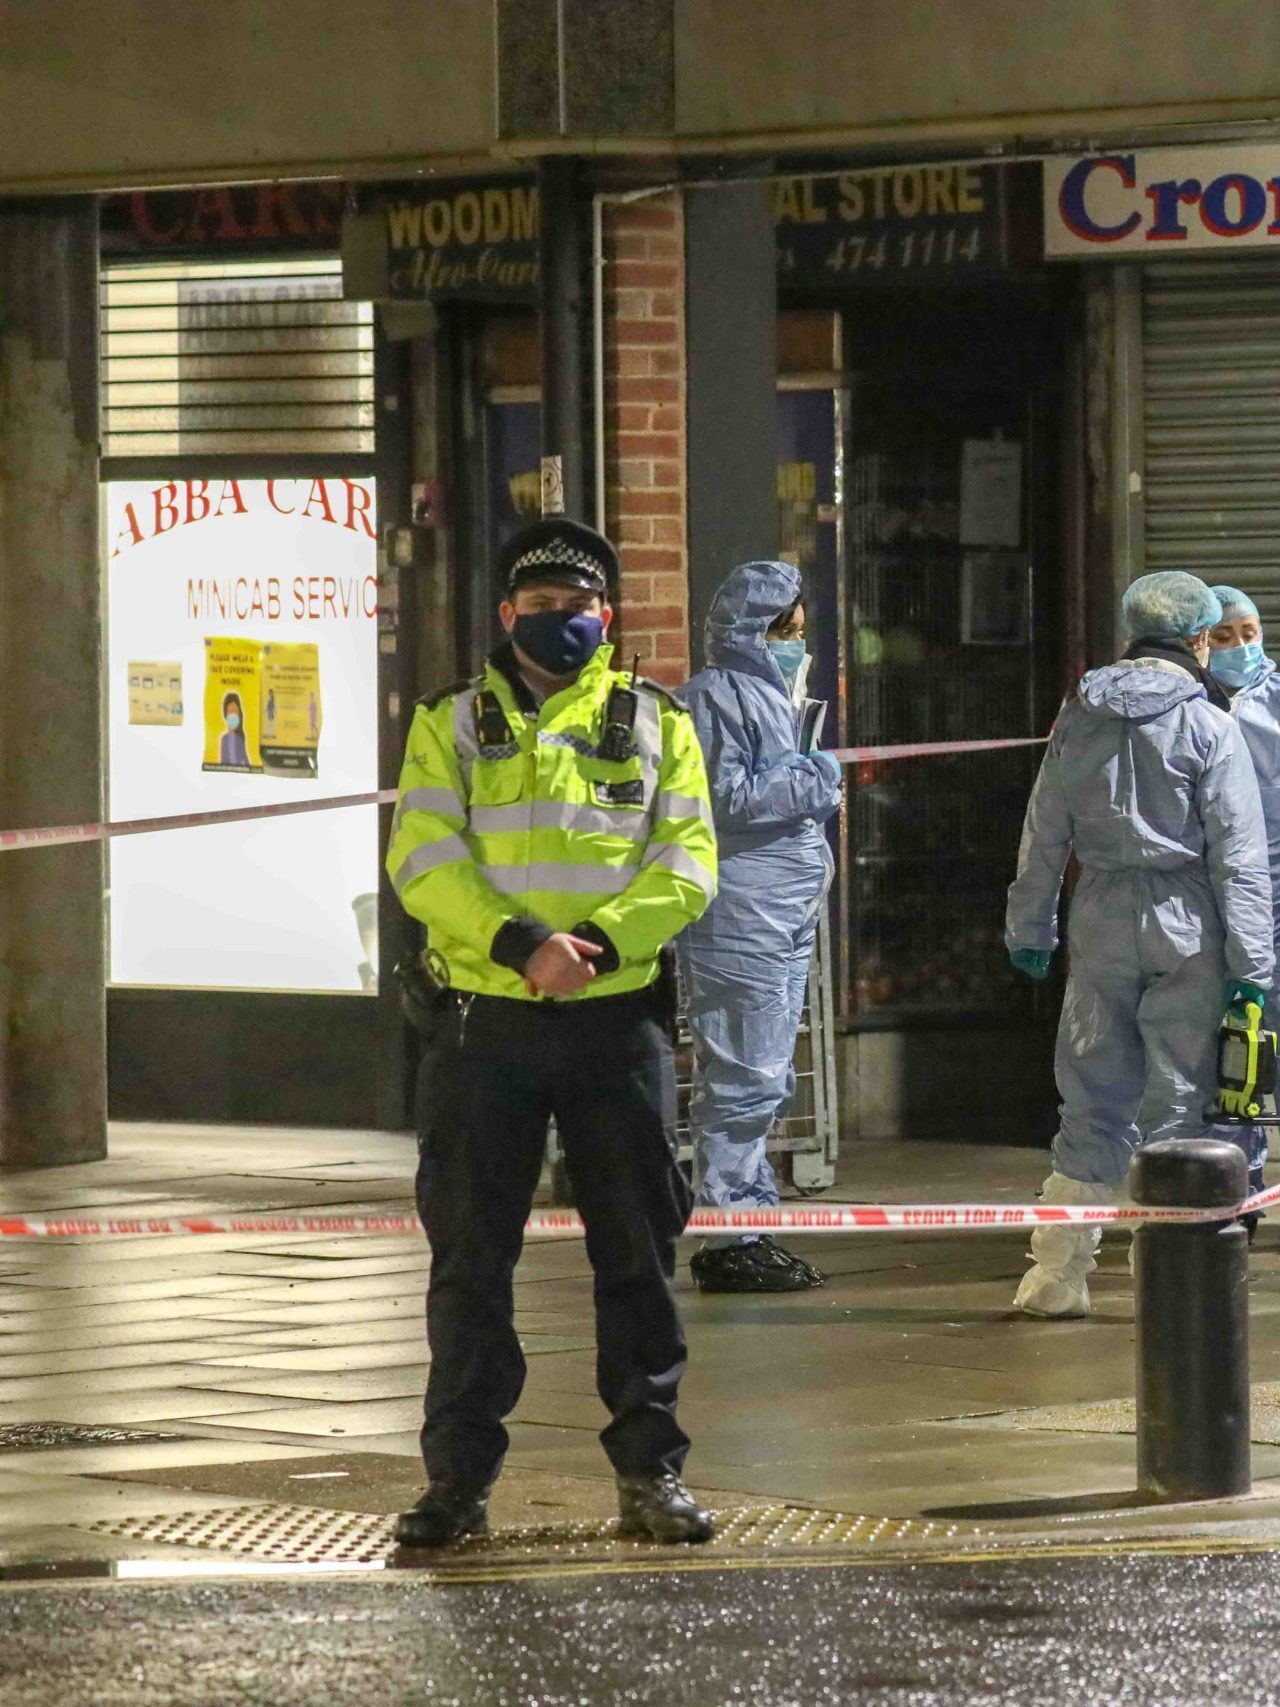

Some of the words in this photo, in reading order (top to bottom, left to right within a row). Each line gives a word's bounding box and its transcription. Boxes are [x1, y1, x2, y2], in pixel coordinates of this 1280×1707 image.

[838, 167, 984, 221] STORE
[111, 480, 248, 557] ABBA
[267, 478, 377, 539] CAR
[188, 577, 281, 619] MINICAB
